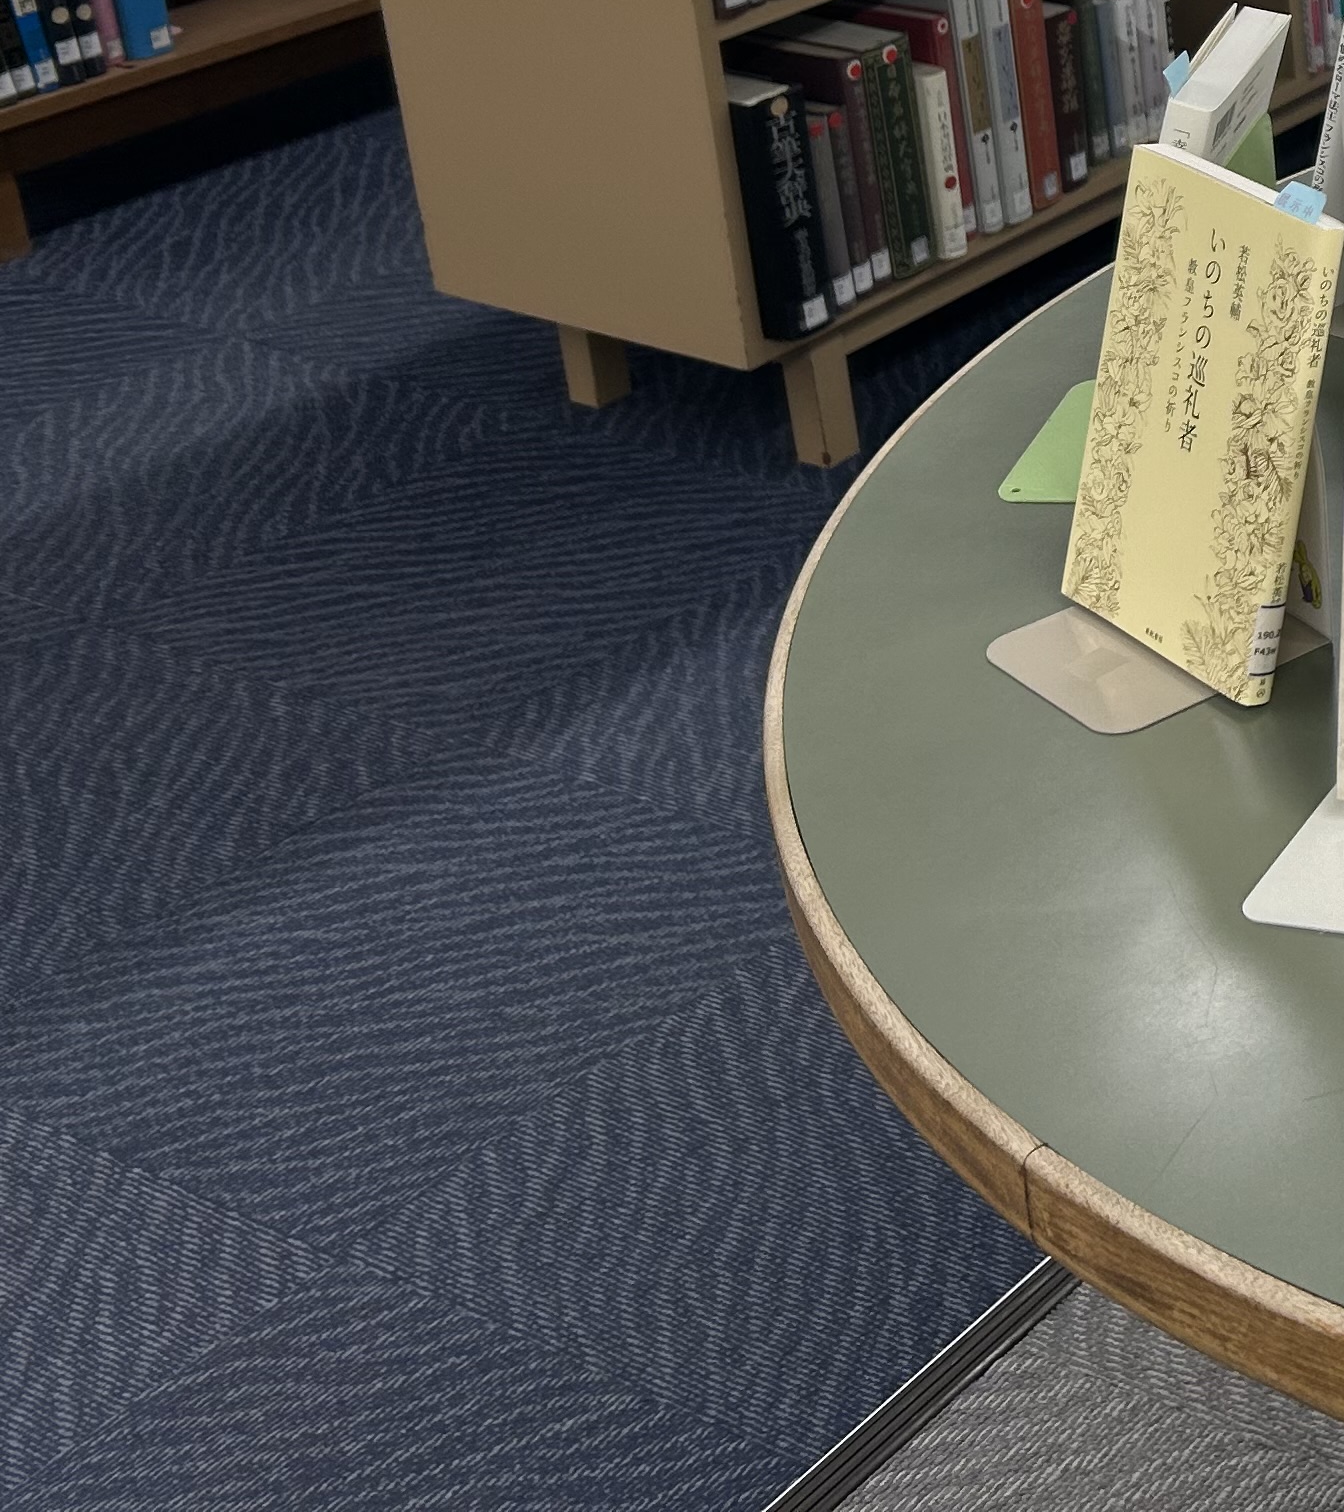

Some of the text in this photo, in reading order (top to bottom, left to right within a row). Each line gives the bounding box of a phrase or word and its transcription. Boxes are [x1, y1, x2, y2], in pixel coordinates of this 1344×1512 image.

[1165, 257, 1198, 433] 教皇フランシスコの祈り
[1178, 227, 1226, 452] いのちの巡礼者
[1309, 266, 1335, 369] いのちの巡礼者
